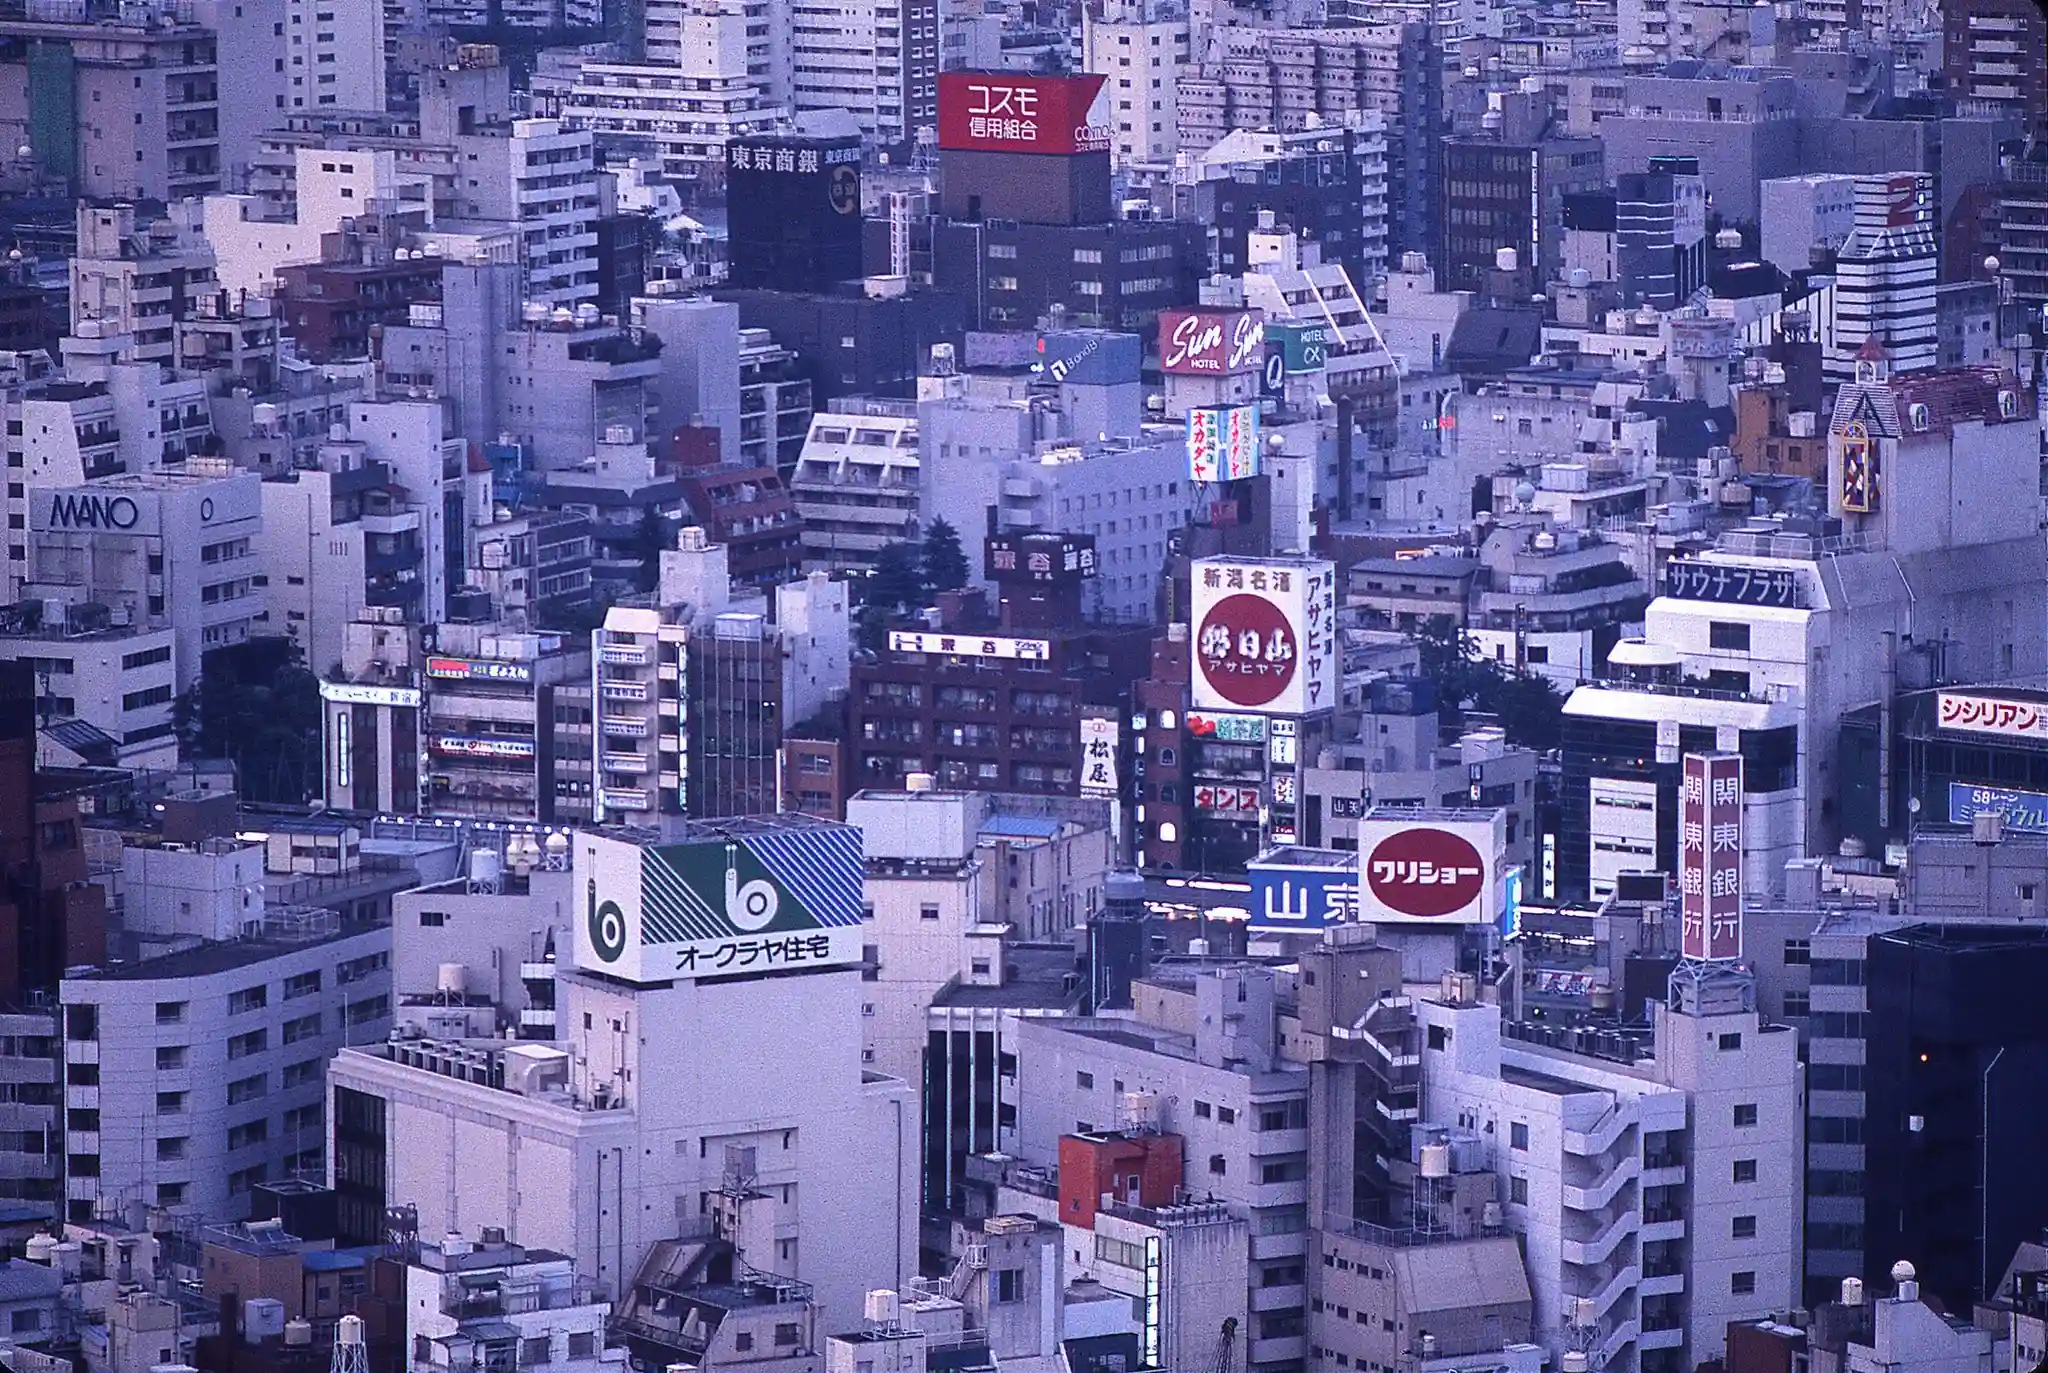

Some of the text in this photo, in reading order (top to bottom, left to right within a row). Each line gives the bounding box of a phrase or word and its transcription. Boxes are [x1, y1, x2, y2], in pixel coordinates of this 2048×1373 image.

[968, 85, 1038, 116] コスモ
[969, 116, 1038, 141] 信用組合
[731, 145, 818, 173] 東京商銀
[1166, 315, 1222, 368] Sun
[1229, 314, 1264, 369] Sun
[1301, 329, 1324, 343] HOTEL
[1191, 359, 1221, 370] HOTEL
[50, 494, 139, 529] MANO
[1307, 575, 1322, 705] アサヒヤマ
[1208, 659, 1286, 677] アサヒヤマ
[1943, 698, 2037, 730] シシリアン
[1196, 787, 1261, 811] タンス
[1972, 789, 2019, 805] 58レーン
[1373, 860, 1479, 885] ワリショー
[1685, 776, 1703, 940] 関東銀行
[1712, 777, 1738, 941] 関東銀行
[675, 935, 834, 970] オークラヤ住宅
